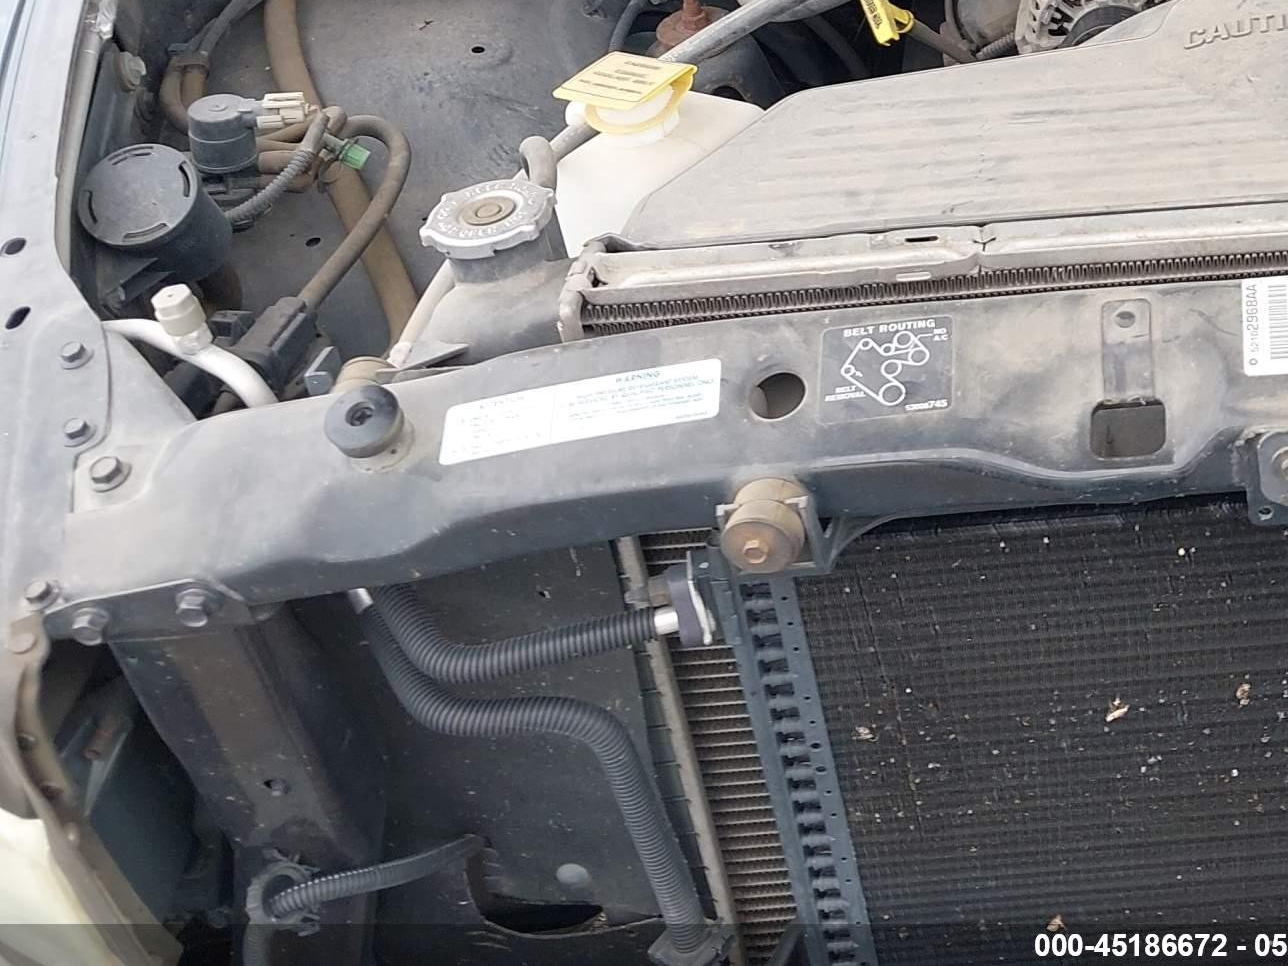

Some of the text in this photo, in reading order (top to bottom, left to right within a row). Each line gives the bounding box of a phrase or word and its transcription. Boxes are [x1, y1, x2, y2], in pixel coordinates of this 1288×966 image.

[843, 319, 936, 338] BELT ROUTING
[835, 385, 857, 394] BELT
